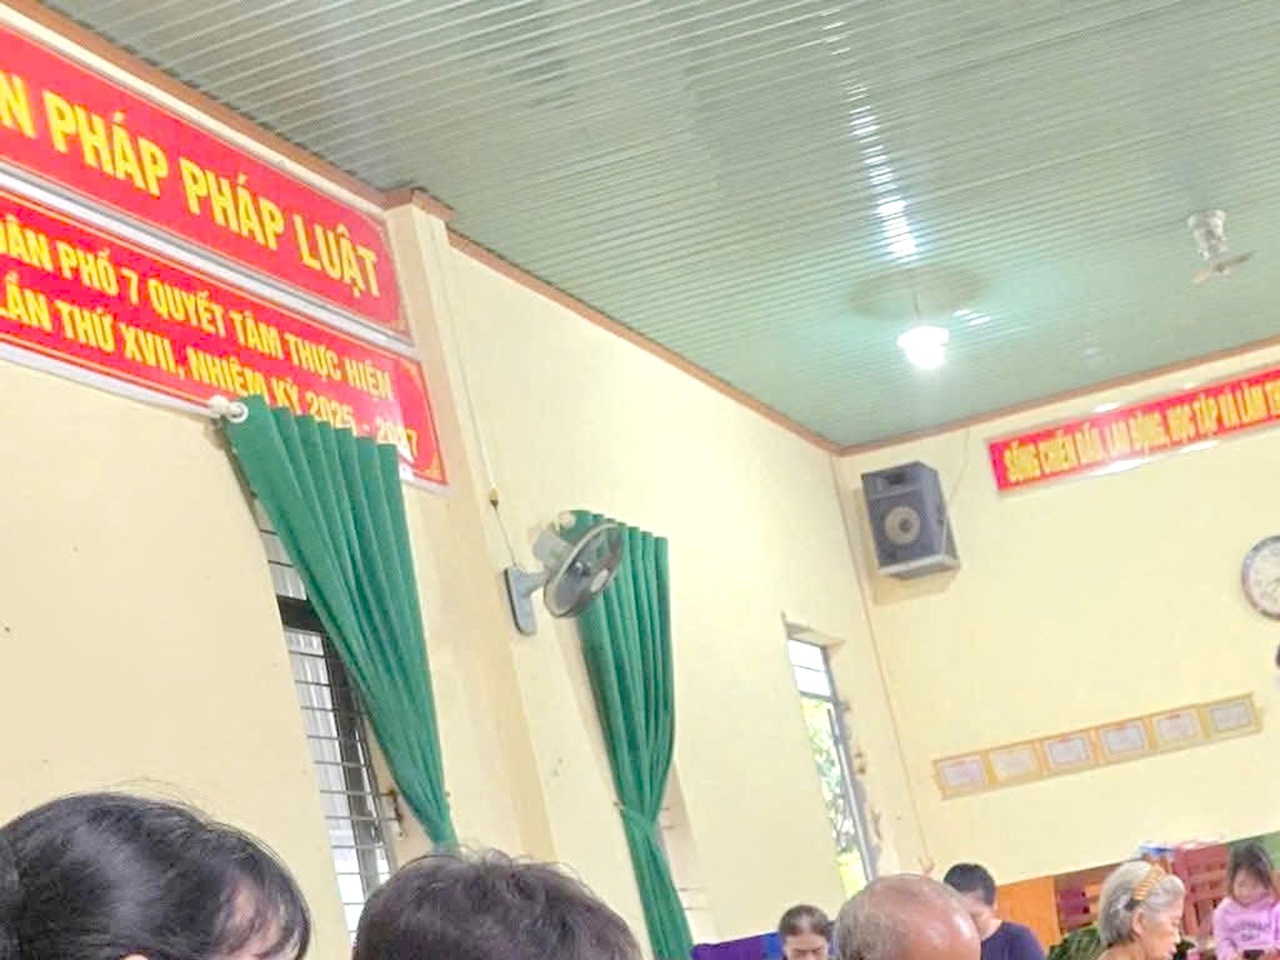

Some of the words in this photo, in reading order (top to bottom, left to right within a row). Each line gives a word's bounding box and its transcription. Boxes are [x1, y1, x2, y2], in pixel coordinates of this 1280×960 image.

[42, 89, 169, 197] PHÁP
[179, 157, 285, 250] PHÁP
[293, 215, 380, 298] LUẬT
[54, 299, 115, 354] THỨ
[118, 321, 184, 380] XVII,
[56, 247, 119, 296] PHỐ
[120, 267, 139, 305] 7
[148, 278, 226, 338] QUYẾT
[229, 309, 284, 360] TÂM
[284, 332, 342, 382] THỰC
[344, 356, 394, 402] HIỆN
